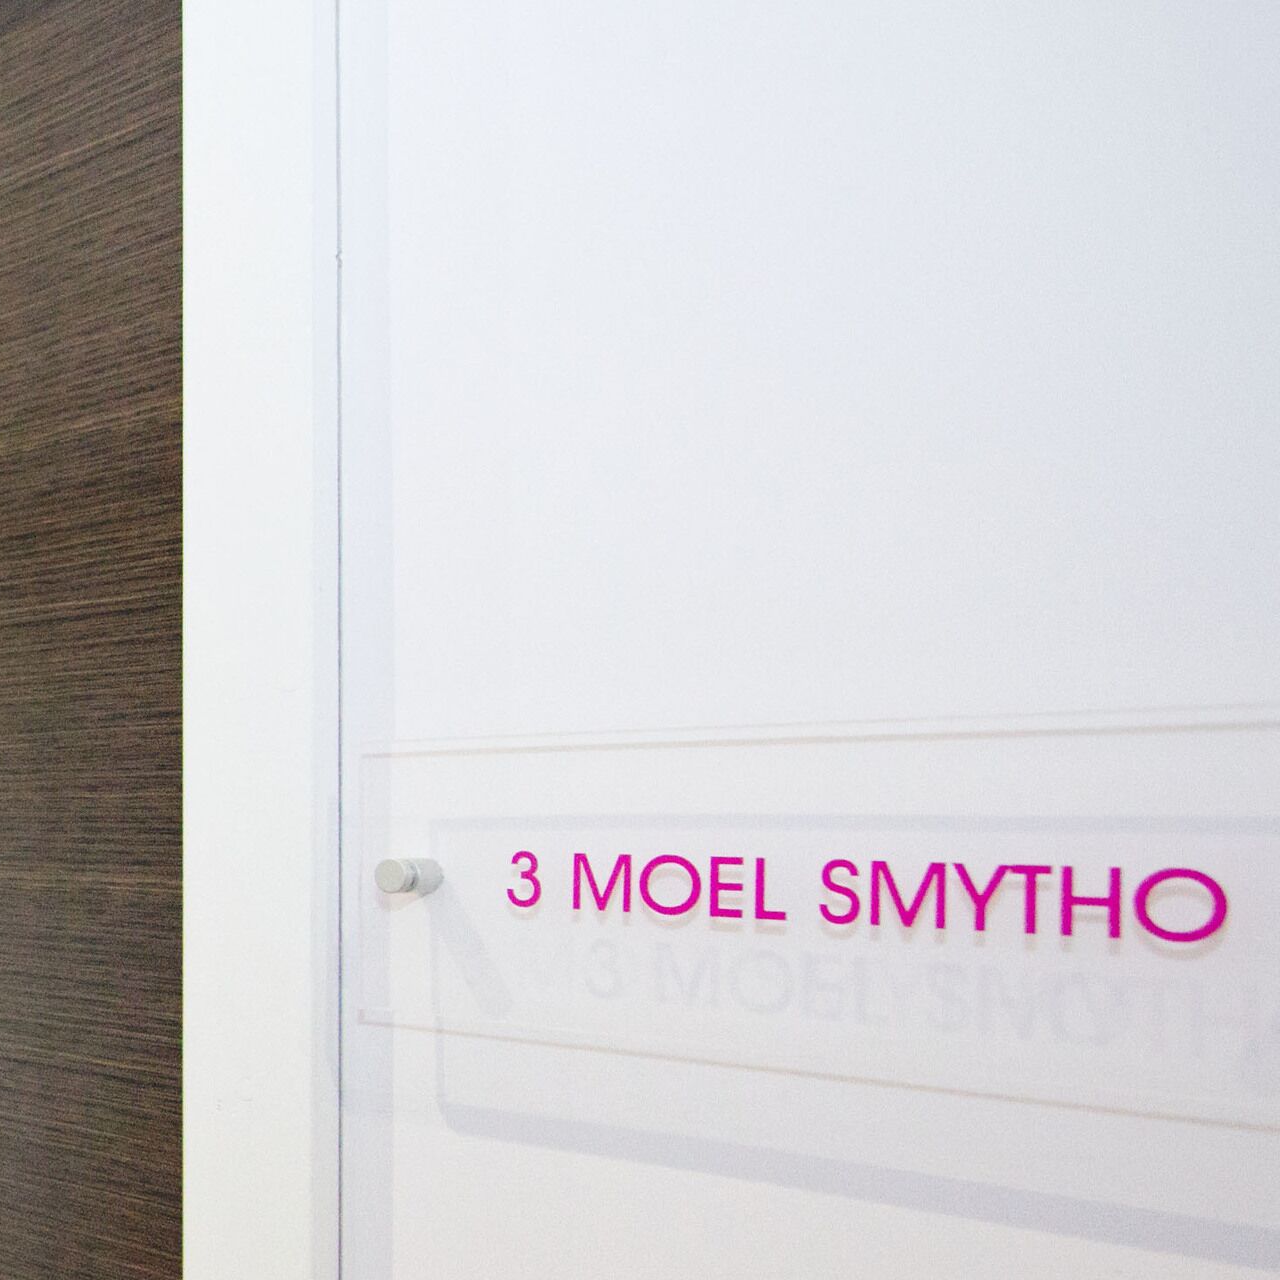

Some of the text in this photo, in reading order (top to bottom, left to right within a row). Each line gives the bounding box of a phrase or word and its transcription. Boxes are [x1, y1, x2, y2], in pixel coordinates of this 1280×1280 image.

[506, 850, 1227, 943] 3 MOEL SMYTHO
